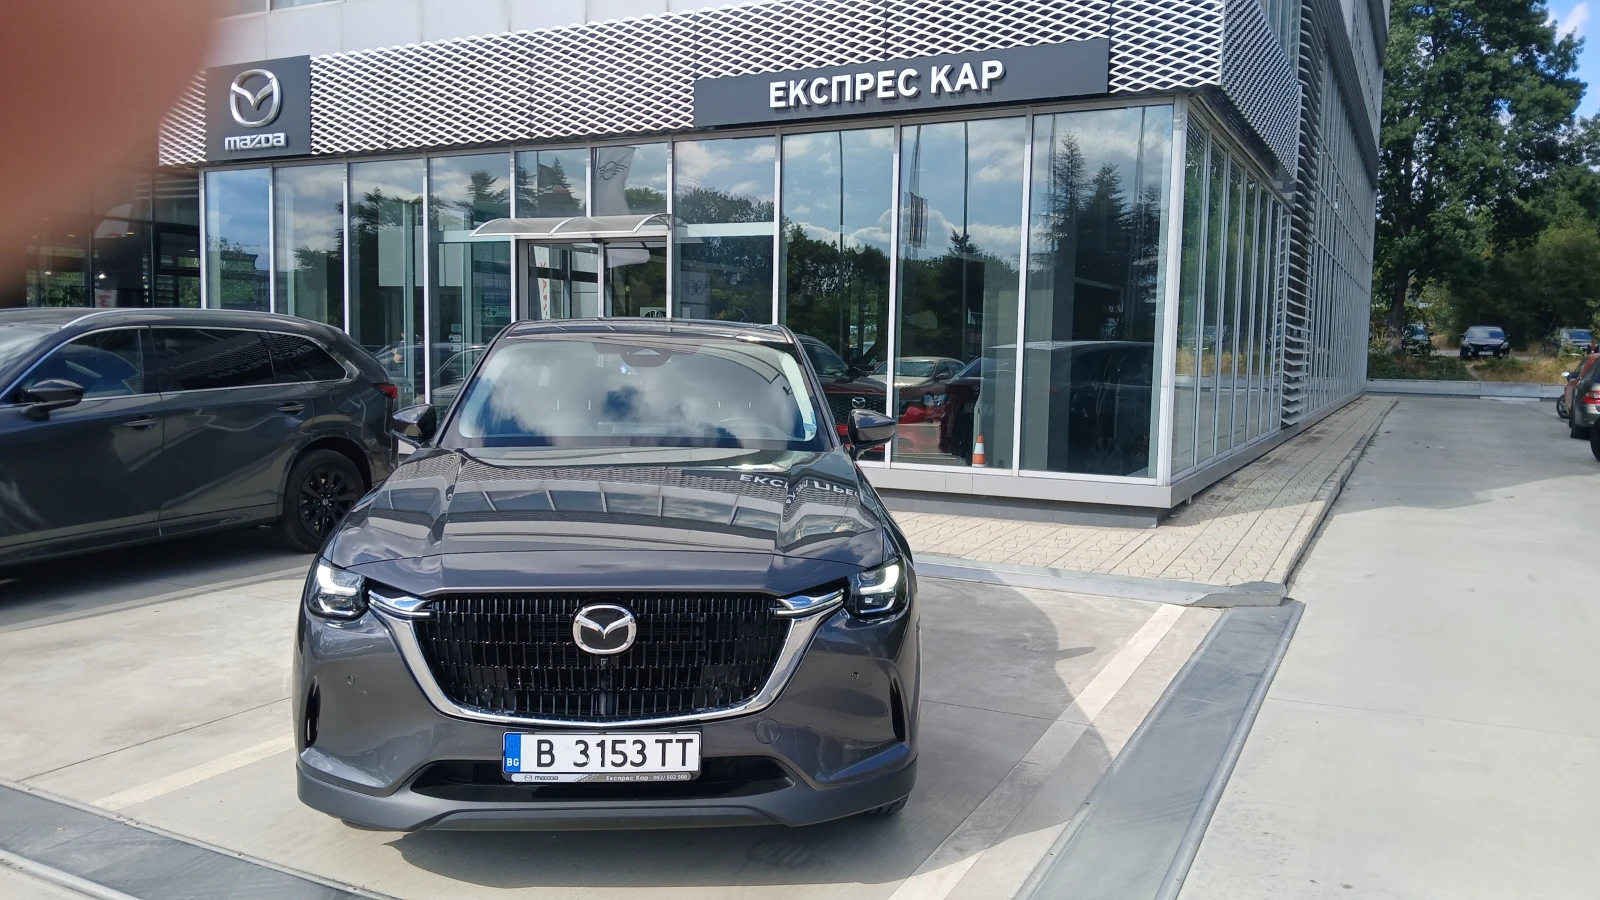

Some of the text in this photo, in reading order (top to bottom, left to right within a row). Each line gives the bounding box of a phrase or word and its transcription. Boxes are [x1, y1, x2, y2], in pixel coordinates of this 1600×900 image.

[769, 60, 1005, 109] ЕКСПРЕС КАР
[224, 132, 287, 151] mazda
[505, 757, 520, 767] BG
[536, 739, 694, 768] B 3153 TT
